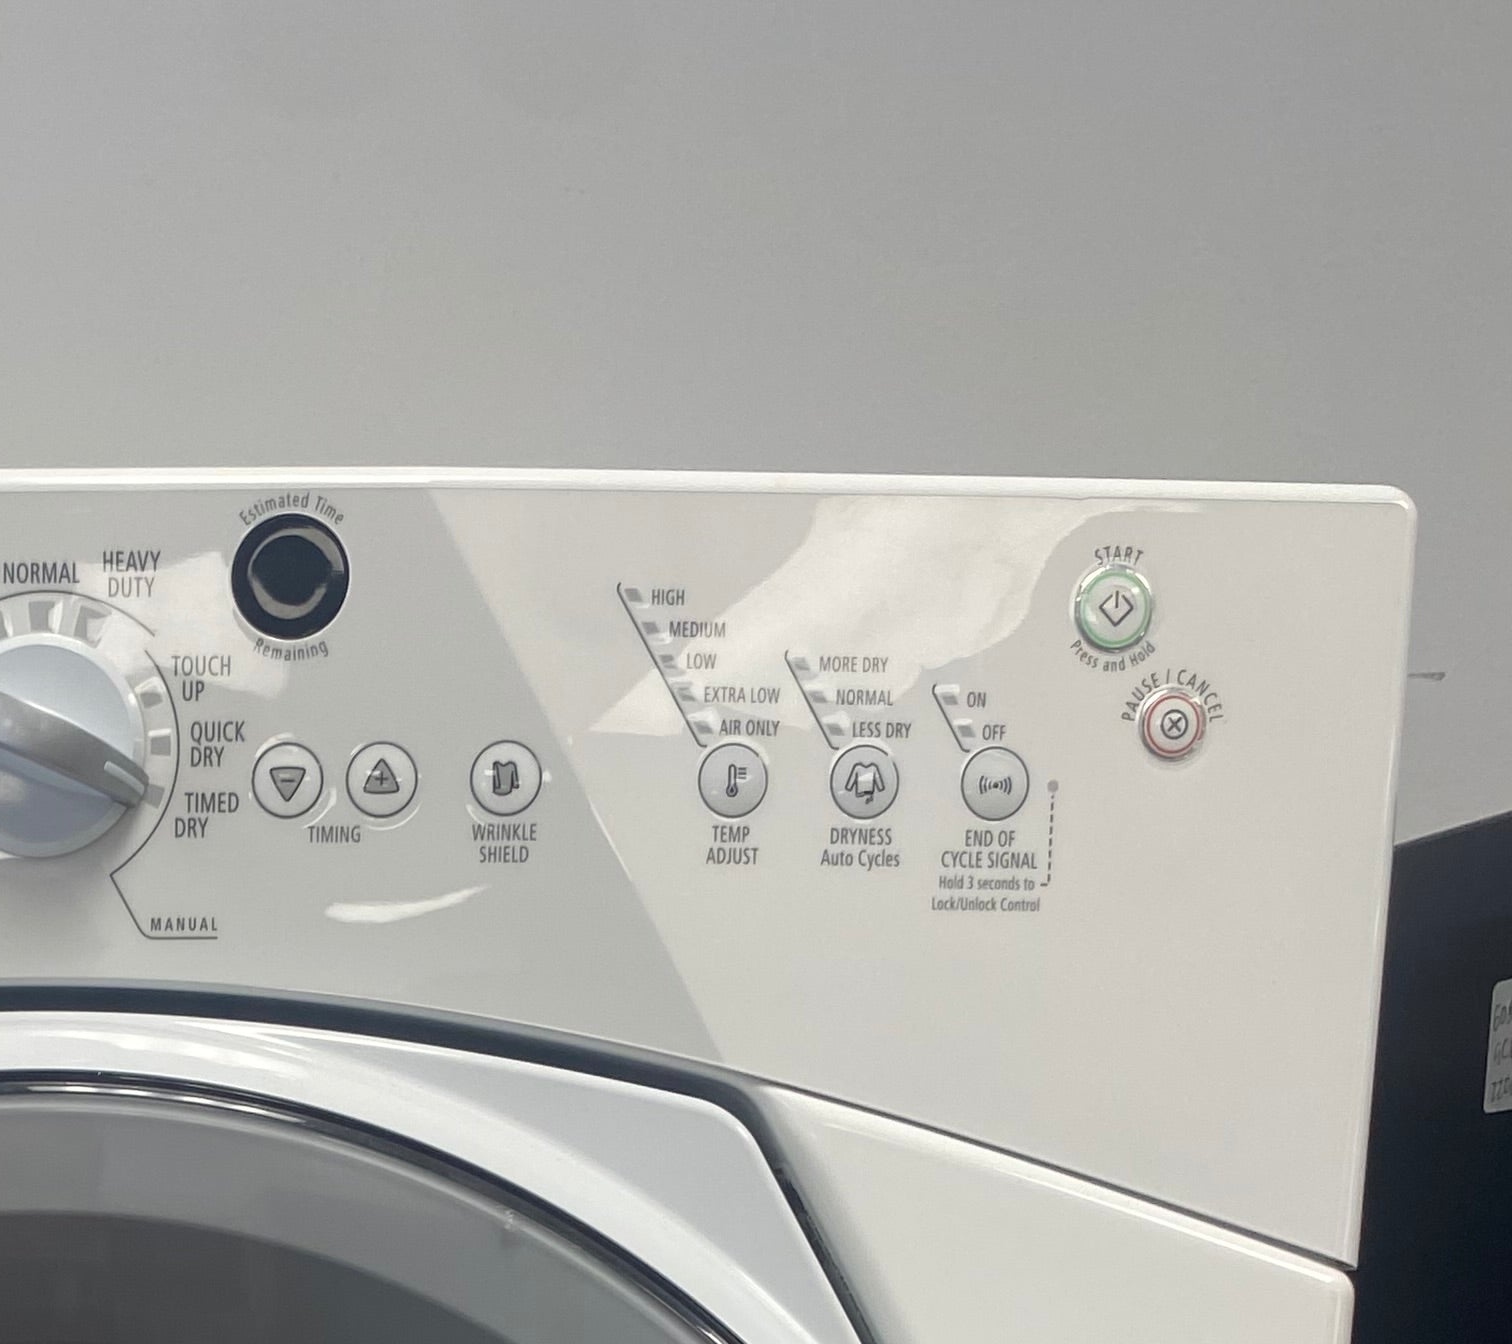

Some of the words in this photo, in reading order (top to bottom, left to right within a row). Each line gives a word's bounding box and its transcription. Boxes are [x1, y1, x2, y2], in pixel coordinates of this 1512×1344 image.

[240, 492, 309, 526] Estimated
[315, 496, 344, 525] Time
[103, 551, 161, 573] HEAVY
[1095, 545, 1144, 565] START
[3, 562, 80, 585] NORMAL
[108, 577, 155, 598] DUTY
[651, 590, 684, 605] HIGH
[669, 622, 726, 639] MEDIUM
[253, 638, 329, 661] Remaining
[1070, 639, 1098, 668] Press
[1103, 658, 1125, 672] and
[1130, 641, 1156, 667] Hold
[172, 655, 232, 677] TOUCH
[686, 654, 717, 670] LOW
[819, 656, 858, 673] MORE
[861, 657, 888, 674] DRY
[182, 681, 205, 702] UP
[704, 687, 745, 704] EXTRA
[750, 688, 780, 705] LOW
[836, 689, 893, 706] NORMAL
[967, 692, 986, 708] ON
[1121, 672, 1160, 721] PAUSE
[1177, 669, 1224, 723] CANCEL
[190, 721, 245, 743] QUICK
[719, 720, 742, 736] AIR
[746, 721, 779, 738] ONLY
[852, 722, 883, 738] LESS
[886, 722, 912, 740] DRY
[982, 724, 1006, 741] OFF
[190, 746, 224, 768] DRY
[184, 792, 239, 814] TIMED
[174, 817, 208, 839] DRY
[308, 826, 361, 844] TIMING
[472, 824, 537, 842] WRINKLE
[712, 826, 750, 844] TEMP
[830, 828, 892, 846] DRYNESS
[965, 830, 993, 847] END
[997, 830, 1016, 848] OF
[480, 846, 529, 864] SHIELD
[706, 848, 759, 865] ADJUST
[821, 849, 853, 867] Auto
[858, 849, 900, 869] Cycles
[941, 851, 983, 869] CYCLE
[986, 852, 1037, 870] SIGNAL
[939, 876, 964, 890] Hold
[967, 876, 974, 890] 3
[977, 876, 1020, 891] seconds
[1024, 877, 1035, 891] to
[931, 898, 997, 912] Lock/Unlock
[1000, 898, 1040, 912] Control
[150, 918, 218, 932] MANUAL
